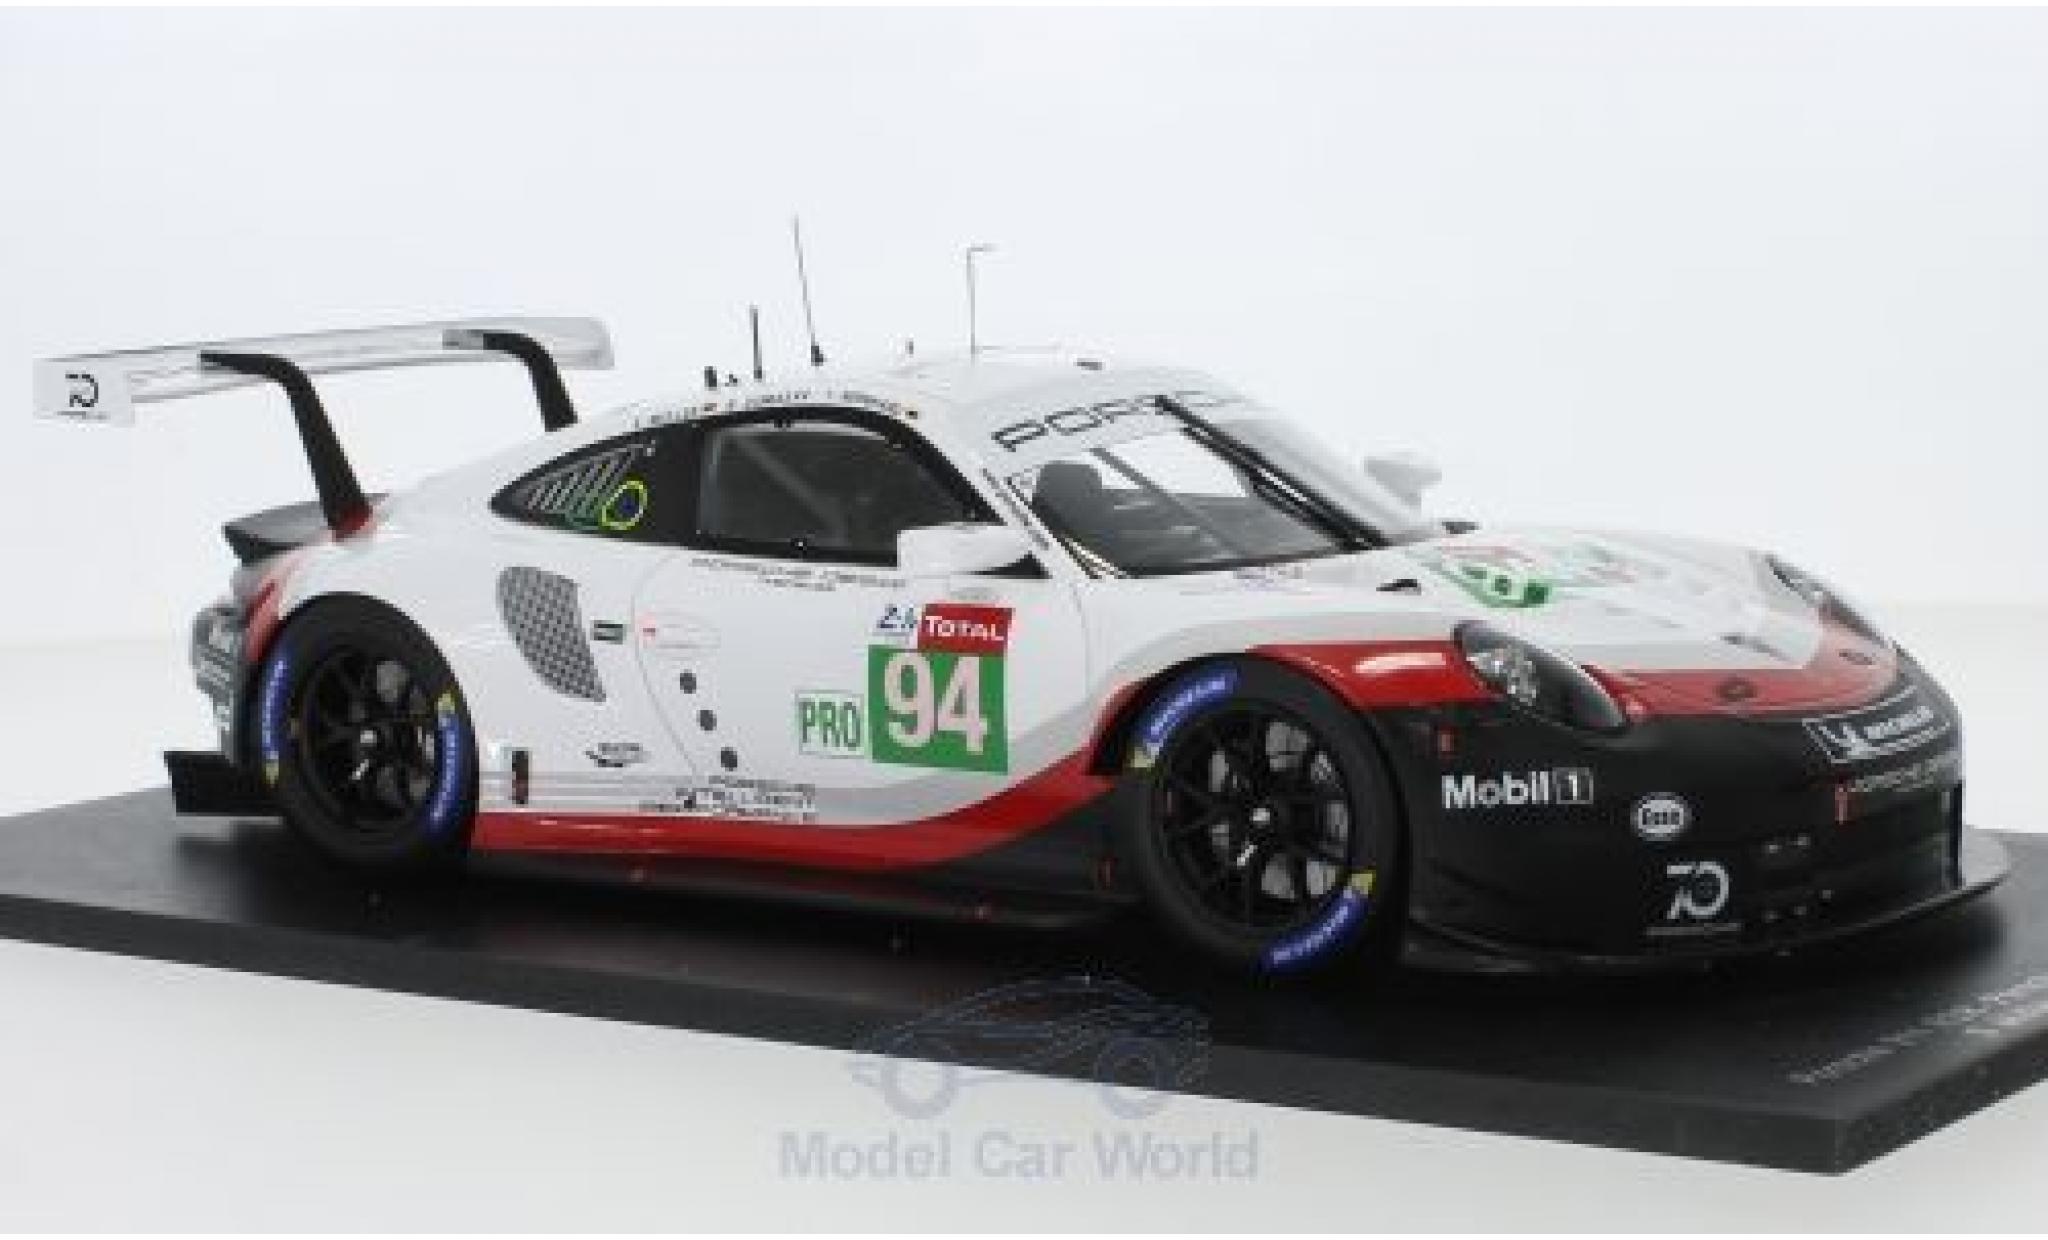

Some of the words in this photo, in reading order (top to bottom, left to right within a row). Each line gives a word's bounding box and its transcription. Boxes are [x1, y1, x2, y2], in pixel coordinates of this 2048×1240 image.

[925, 615, 1005, 641] TOTAL
[799, 699, 862, 752] PRO
[885, 653, 988, 755] 94
[1441, 770, 1549, 809] Mobil
